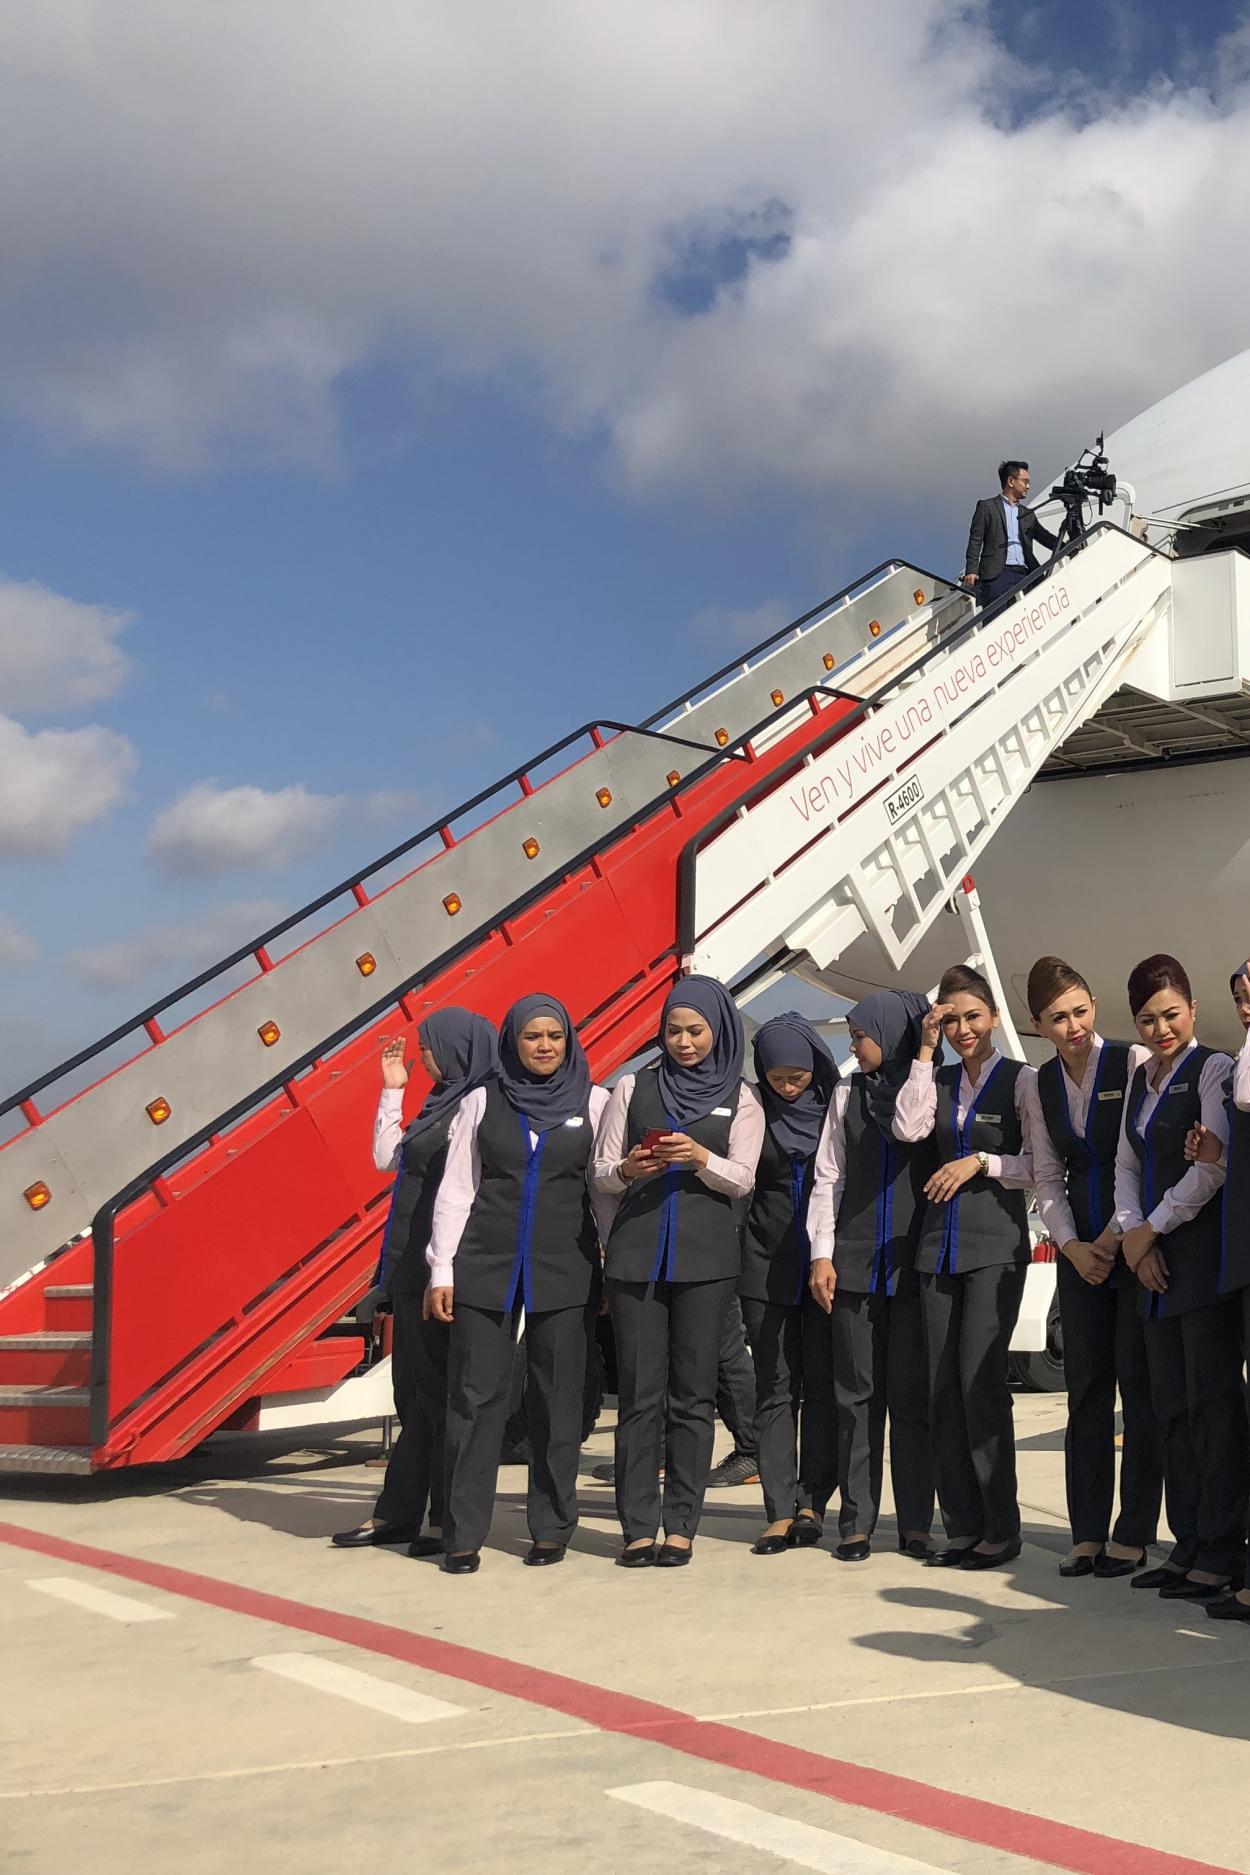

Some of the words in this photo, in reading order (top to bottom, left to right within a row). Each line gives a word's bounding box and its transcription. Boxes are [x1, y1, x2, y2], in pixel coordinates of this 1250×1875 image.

[789, 776, 839, 822] Ven
[836, 760, 853, 799] y
[852, 736, 897, 773] vive
[895, 698, 933, 741] una
[933, 654, 987, 711] nueva
[986, 584, 1070, 667] experiencia
[887, 781, 920, 819] R-4600
